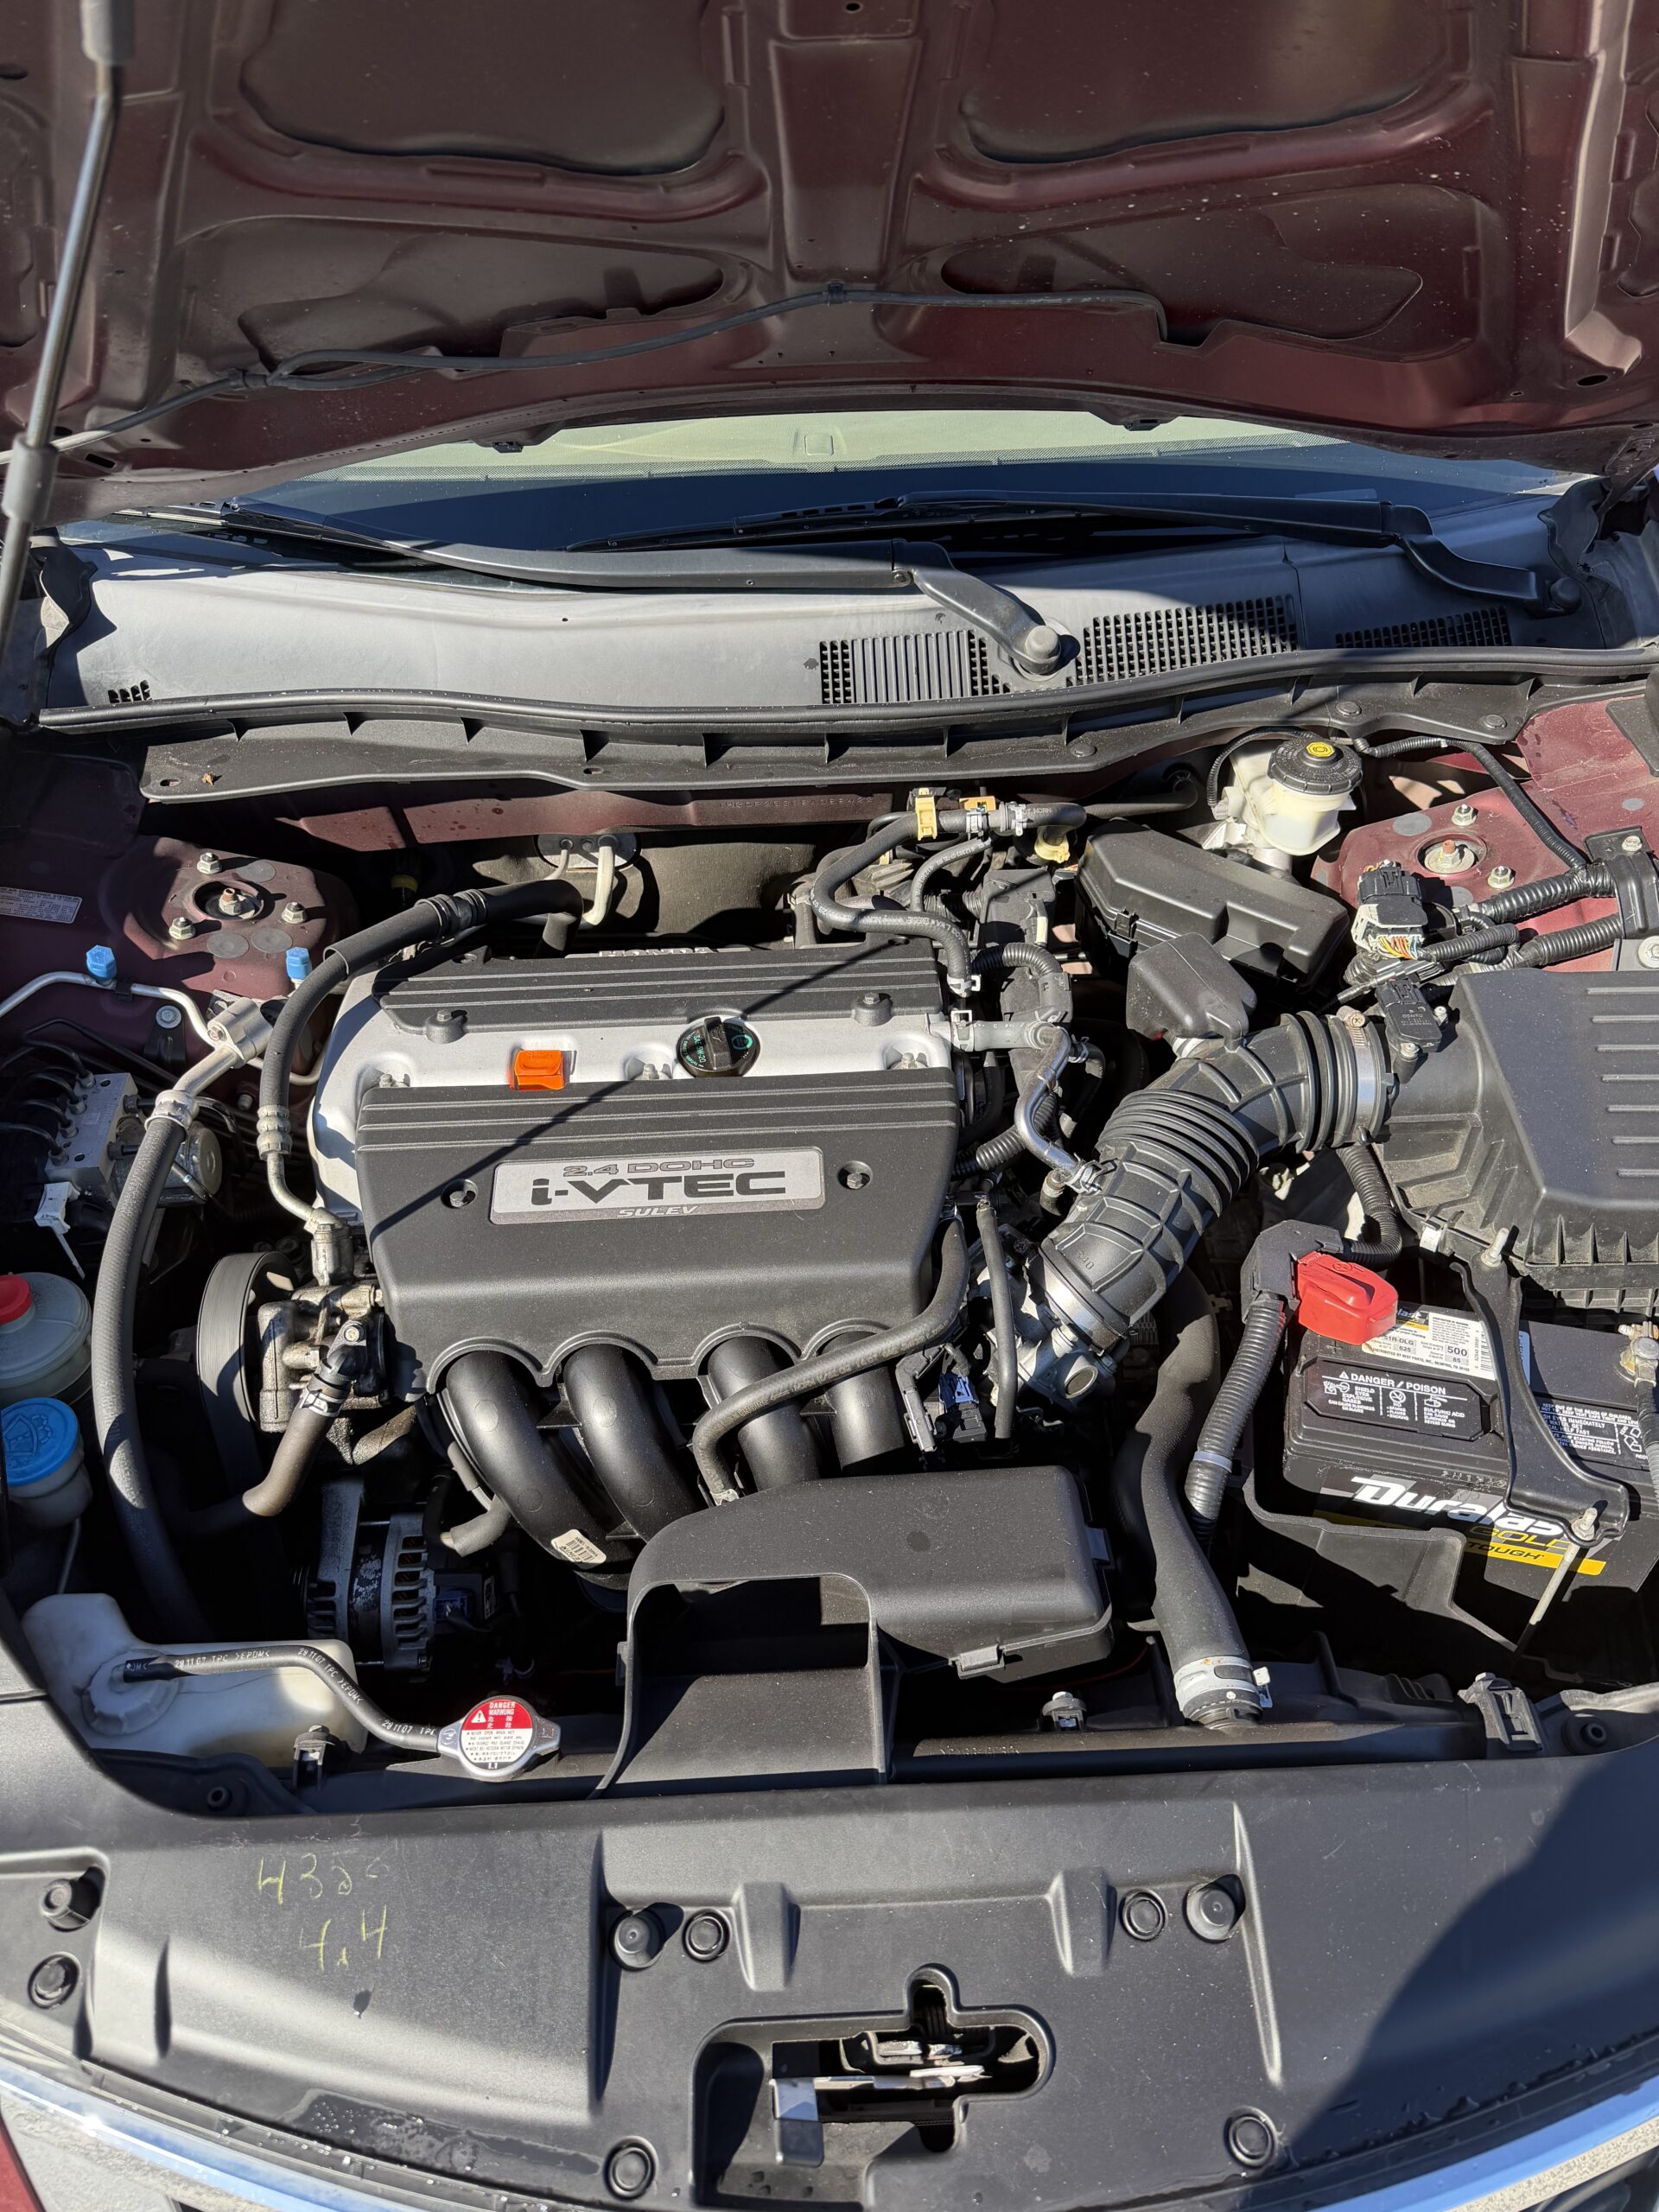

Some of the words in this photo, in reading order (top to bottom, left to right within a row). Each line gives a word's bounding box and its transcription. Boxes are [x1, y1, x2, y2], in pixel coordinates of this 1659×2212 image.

[563, 1164, 620, 1178] 2.4
[627, 1158, 756, 1174] DOHC
[531, 1172, 785, 1206] i-VTEC
[617, 1205, 699, 1218] SULEV
[1447, 1346, 1468, 1357] 500
[1351, 1372, 1395, 1388] DANGER
[1406, 1382, 1446, 1395] POISON
[1342, 1393, 1373, 1402] EXPLOSIVE
[1423, 1407, 1451, 1416] SULFURIC
[1567, 1418, 1605, 1428] IMMEDIATELY
[1351, 1476, 1569, 1539] Duralas
[1471, 1526, 1573, 1551] GOLD
[1468, 1541, 1541, 1560] TOUGH
[211, 1654, 228, 1663] TPC
[324, 1663, 340, 1678] TPC
